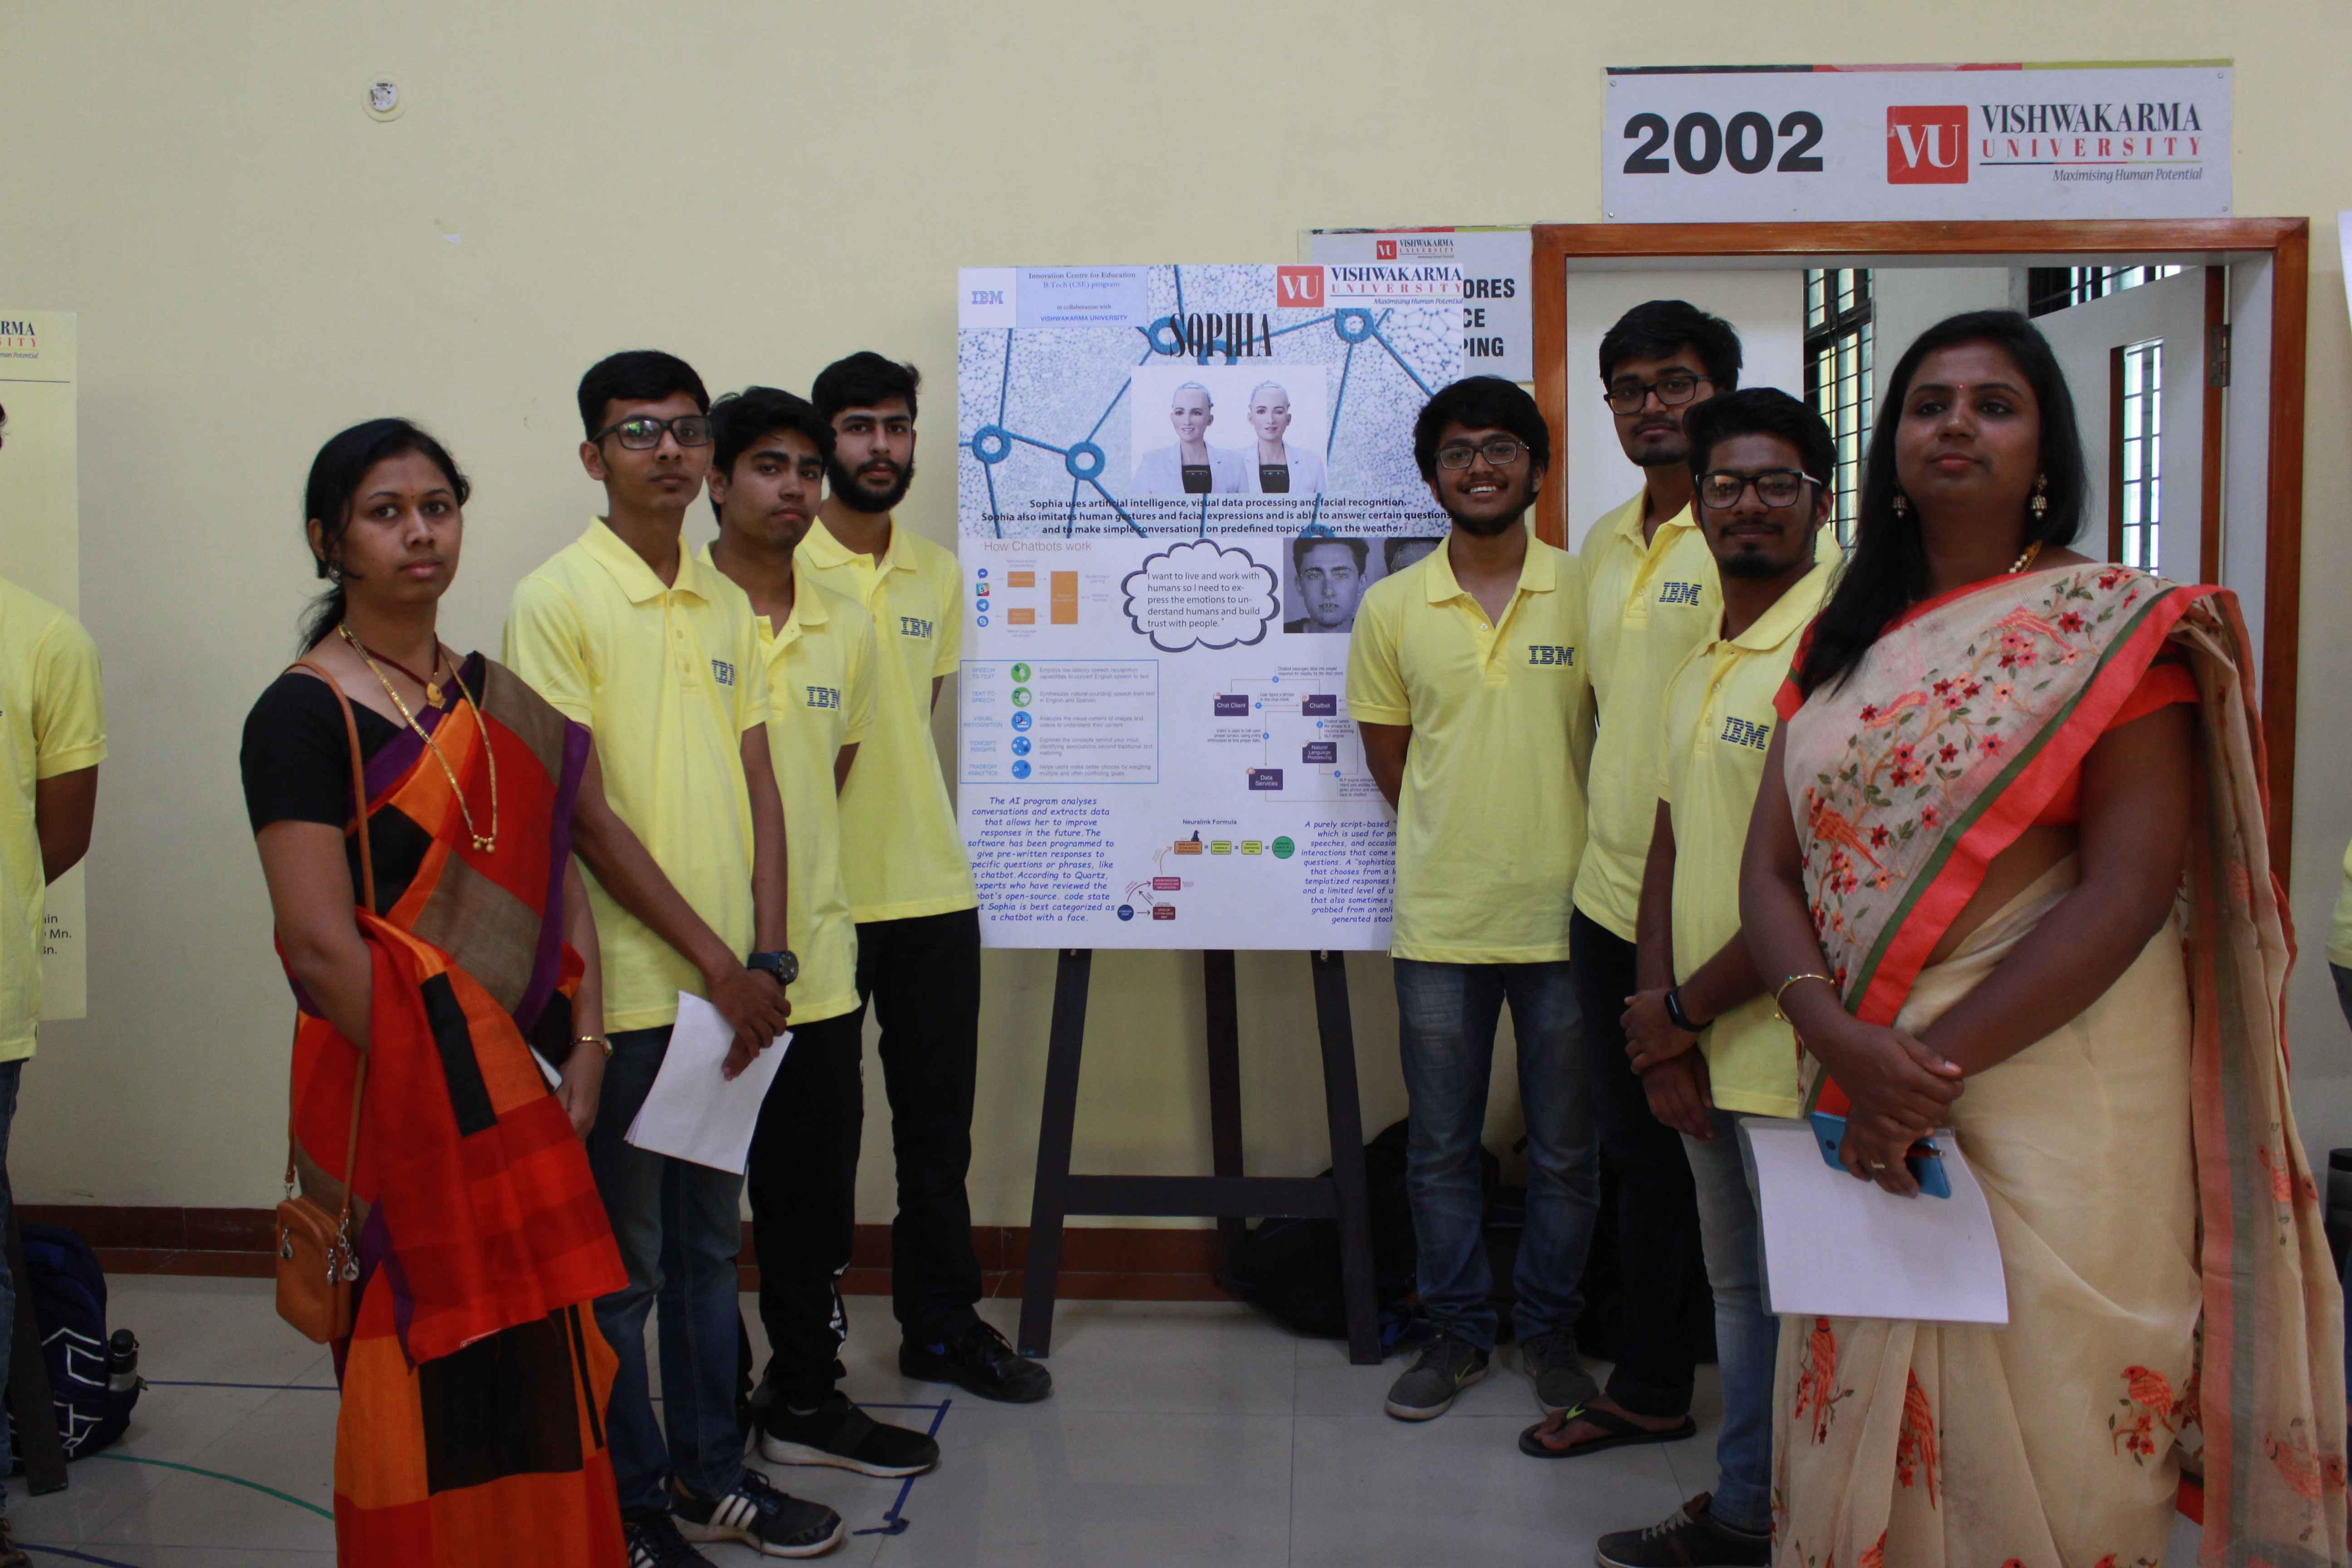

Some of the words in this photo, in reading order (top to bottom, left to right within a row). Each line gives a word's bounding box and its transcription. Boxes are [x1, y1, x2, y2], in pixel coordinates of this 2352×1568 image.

[1980, 103, 2202, 133] VISHWAKARMA
[1623, 111, 1823, 174] 2002
[1894, 124, 1960, 168] VU
[1982, 137, 2201, 158] UNIVERSITY
[2053, 170, 2113, 183] Maximising
[2115, 169, 2153, 180] Human
[2156, 168, 2202, 180] Potential
[1379, 245, 1394, 256] VU
[1331, 267, 1462, 281] VISHWAKARMA
[1281, 276, 1318, 299] VU
[1332, 283, 1461, 294] UNIVERSITY
[1464, 279, 1515, 299] ORES
[972, 291, 1003, 304] IBM
[1464, 309, 1485, 328] CE
[0, 321, 35, 336] RMA
[1170, 313, 1273, 358] SOPHIA
[1030, 500, 1063, 509] Sophia
[1130, 500, 1189, 509] intelligence,
[1191, 498, 1219, 507] visual
[1222, 498, 1244, 506] data
[1246, 499, 1297, 508] processing
[1300, 498, 1316, 506] and
[1320, 498, 1345, 506] facial
[1348, 499, 1406, 508] recognition.
[982, 513, 1014, 522] Sophia
[1115, 514, 1156, 522] gestures
[1208, 511, 1263, 521] expressions
[1266, 511, 1284, 519] and
[1297, 511, 1316, 519] able
[1404, 511, 1450, 521] questions
[1103, 525, 1135, 535] simple
[1221, 524, 1273, 533] predefined
[1276, 525, 1304, 533] topics
[1308, 524, 1328, 534] (e.g.
[1363, 524, 1406, 533] weather.)
[985, 541, 1009, 551] How
[1012, 541, 1062, 551] Chatbots
[1066, 541, 1091, 550] work
[1659, 582, 1702, 606] IBM
[901, 616, 933, 640] IBM
[1529, 646, 1574, 666] IBM
[712, 660, 735, 686] IBM
[807, 686, 840, 710] IBM
[1721, 716, 1769, 750] IBM
[1062, 797, 1097, 806] analyses
[1066, 819, 1097, 828] improve
[50, 929, 71, 939] Mn.
